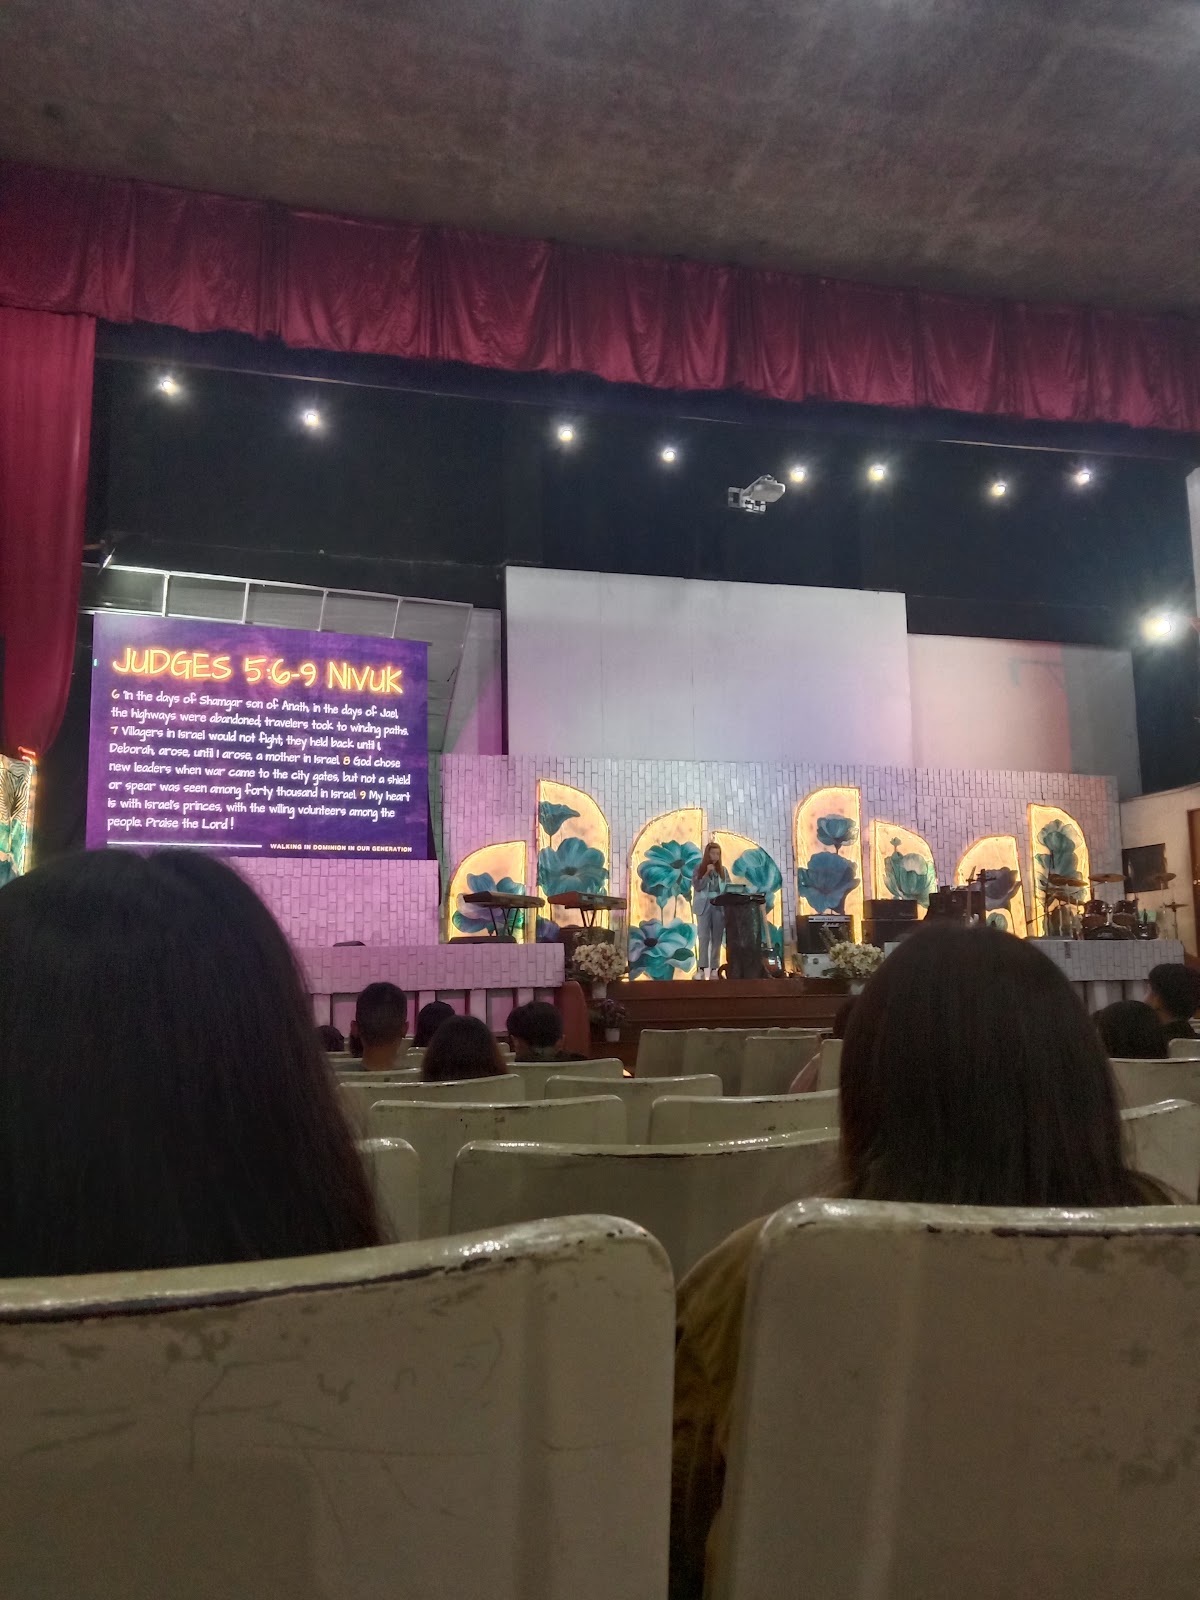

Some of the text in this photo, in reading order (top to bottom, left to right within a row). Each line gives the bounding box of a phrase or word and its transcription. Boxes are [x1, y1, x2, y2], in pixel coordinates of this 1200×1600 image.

[112, 647, 232, 679] JUDGES
[244, 657, 317, 687] 5:6-9
[111, 689, 120, 699] 6
[136, 691, 153, 702] the
[156, 691, 180, 707] days
[183, 692, 197, 704] of
[199, 695, 243, 712] Shamgar
[245, 700, 264, 709] son
[266, 698, 279, 709] of
[313, 703, 321, 713] in
[323, 703, 338, 714] the
[341, 704, 362, 720] days
[365, 705, 377, 717] of
[111, 707, 128, 718] the
[131, 708, 176, 725] highways
[180, 713, 207, 722] were
[265, 717, 308, 729] travelers
[312, 720, 334, 731] took
[337, 722, 347, 732] to
[350, 722, 381, 739] winding
[110, 726, 119, 735] 7
[122, 726, 163, 742] Villagers
[166, 728, 175, 738] in
[178, 730, 206, 740] Israel
[209, 732, 236, 742] would
[239, 733, 256, 743] not
[286, 737, 307, 751] they
[310, 736, 328, 747] held
[331, 737, 354, 749] back
[357, 740, 375, 750] until
[158, 748, 191, 758] arose,
[194, 748, 213, 758] until
[216, 750, 219, 758] I
[222, 751, 253, 761] arose,
[256, 753, 263, 761] a
[265, 753, 300, 763] mother
[303, 754, 311, 763] in
[343, 756, 351, 765] 8
[353, 757, 372, 767] God
[374, 757, 401, 768] chose
[109, 762, 131, 772] new
[134, 762, 171, 774] leaders
[175, 765, 202, 776] when
[205, 767, 225, 777] war
[228, 768, 255, 778] came
[258, 768, 270, 778] to
[273, 769, 288, 779] the
[291, 770, 310, 785] city
[313, 772, 339, 786] gates,
[343, 772, 358, 782] but
[361, 774, 376, 783] not
[387, 774, 411, 785] shield
[109, 781, 122, 790] or
[125, 781, 156, 795] spear
[160, 783, 180, 792] was
[183, 784, 207, 793] seen
[210, 785, 242, 800] among
[244, 783, 273, 801] forty
[276, 786, 318, 798] thousand
[321, 789, 328, 798] in
[360, 790, 366, 800] 9
[369, 790, 383, 805] My
[386, 790, 411, 802] heart
[108, 798, 117, 808] is
[120, 799, 141, 809] with
[183, 801, 223, 815] princes,
[226, 802, 247, 813] with
[250, 803, 266, 814] the
[269, 803, 295, 819] willing
[298, 805, 346, 816] volunteers
[349, 808, 378, 822] among
[381, 807, 395, 818] the
[146, 818, 179, 828] Praise
[182, 818, 199, 829] the
